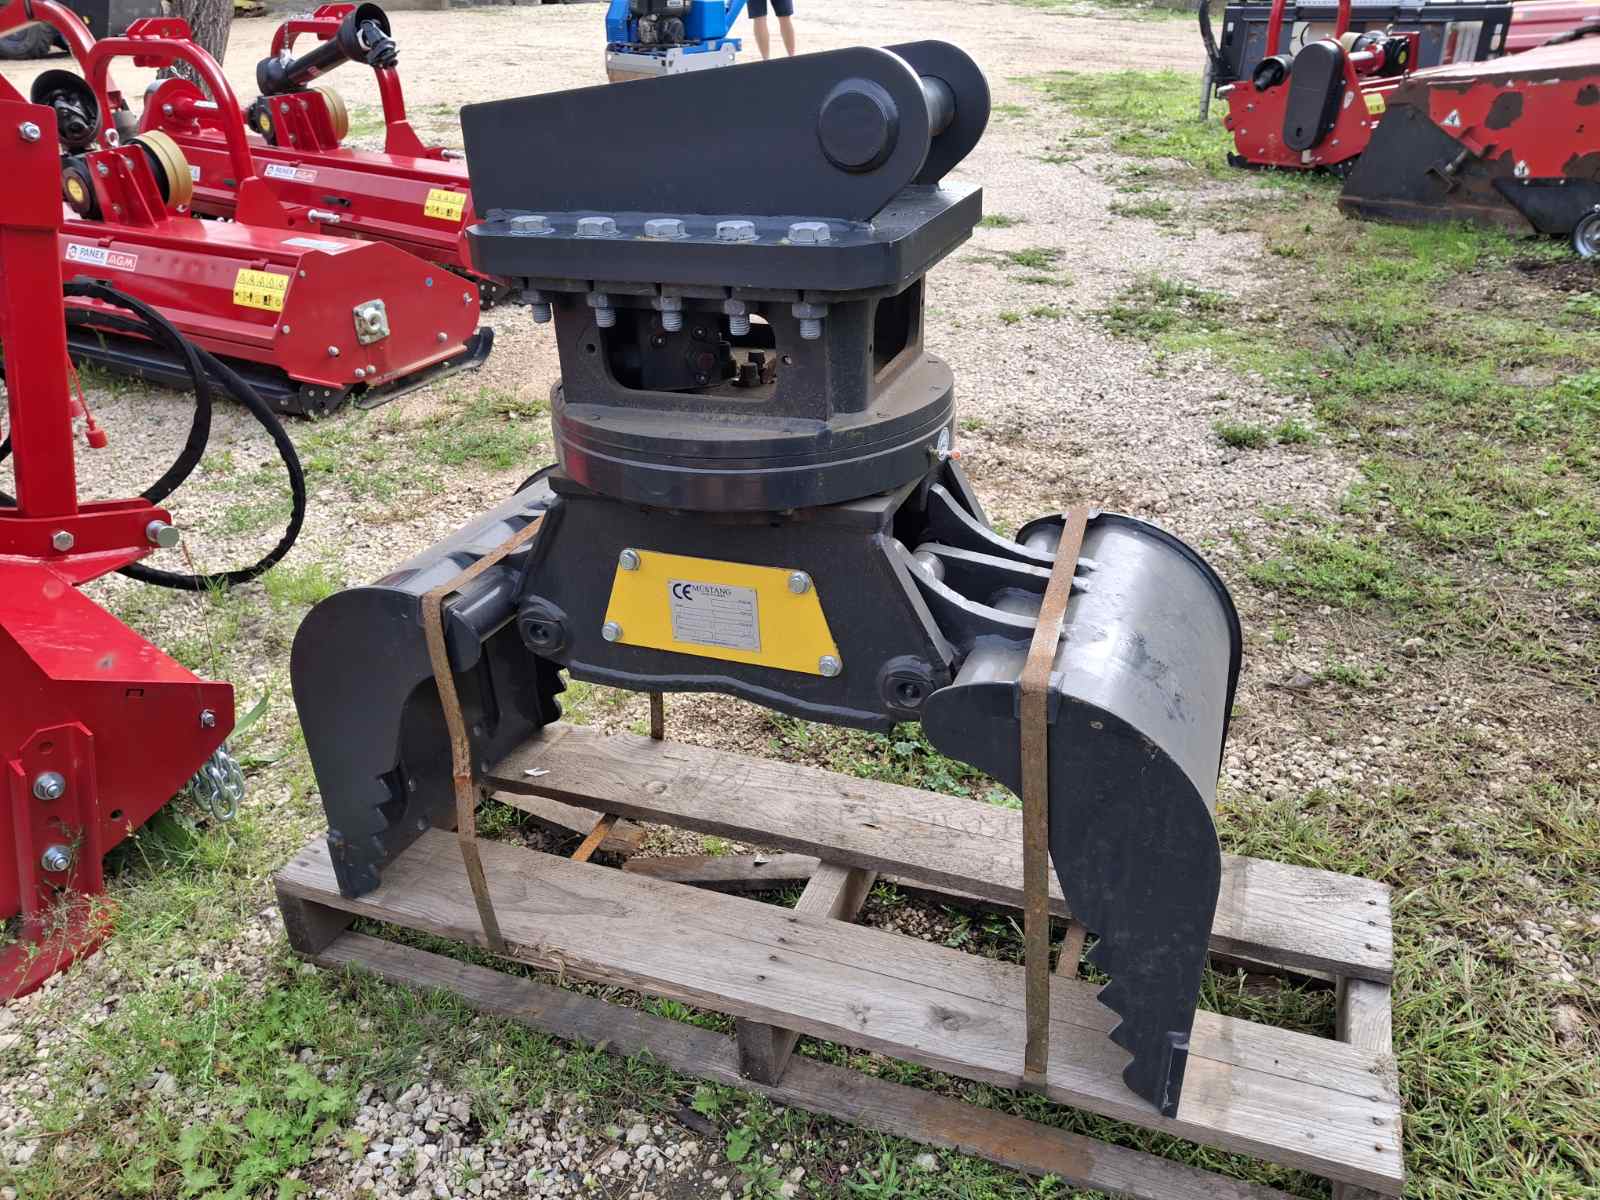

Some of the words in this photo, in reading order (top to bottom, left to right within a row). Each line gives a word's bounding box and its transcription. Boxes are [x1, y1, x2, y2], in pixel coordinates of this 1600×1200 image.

[108, 254, 134, 268] AGM
[673, 583, 693, 600] CE
[691, 584, 732, 596] MUSTANG
